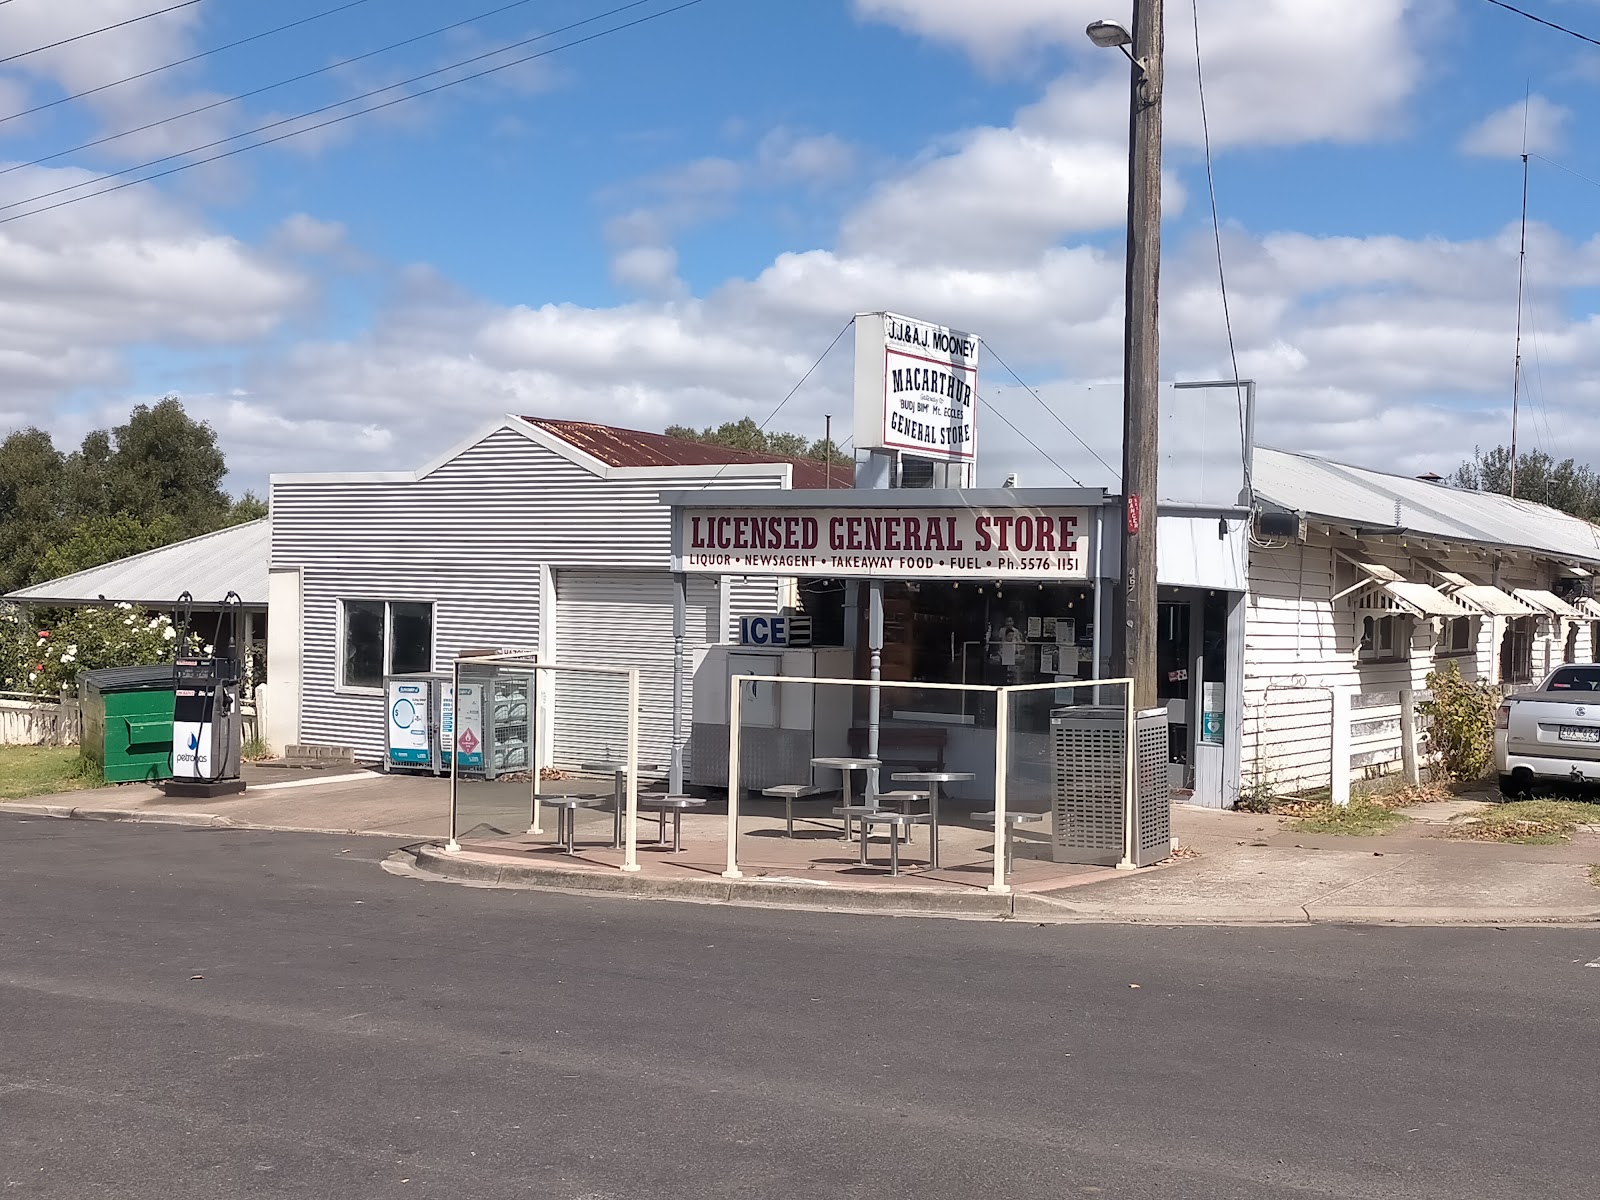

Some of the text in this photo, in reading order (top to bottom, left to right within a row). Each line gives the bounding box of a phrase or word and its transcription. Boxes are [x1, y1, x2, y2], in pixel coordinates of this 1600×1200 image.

[933, 332, 975, 358] MOONEY
[892, 367, 971, 407] MACARTHUR
[943, 407, 963, 420] ECCLES
[891, 411, 970, 445] GENERAL STORE
[691, 516, 1078, 552] LICENSED GENERAL STORE
[689, 553, 731, 567] LIQUOR
[744, 554, 817, 568] NEWSAGENT
[831, 555, 894, 569] TAKEAWAY
[900, 556, 934, 569] FOOD
[950, 557, 982, 570] FUEL
[1057, 558, 1079, 571] 1151
[741, 617, 787, 644] ICE
[177, 753, 207, 764] petroas
